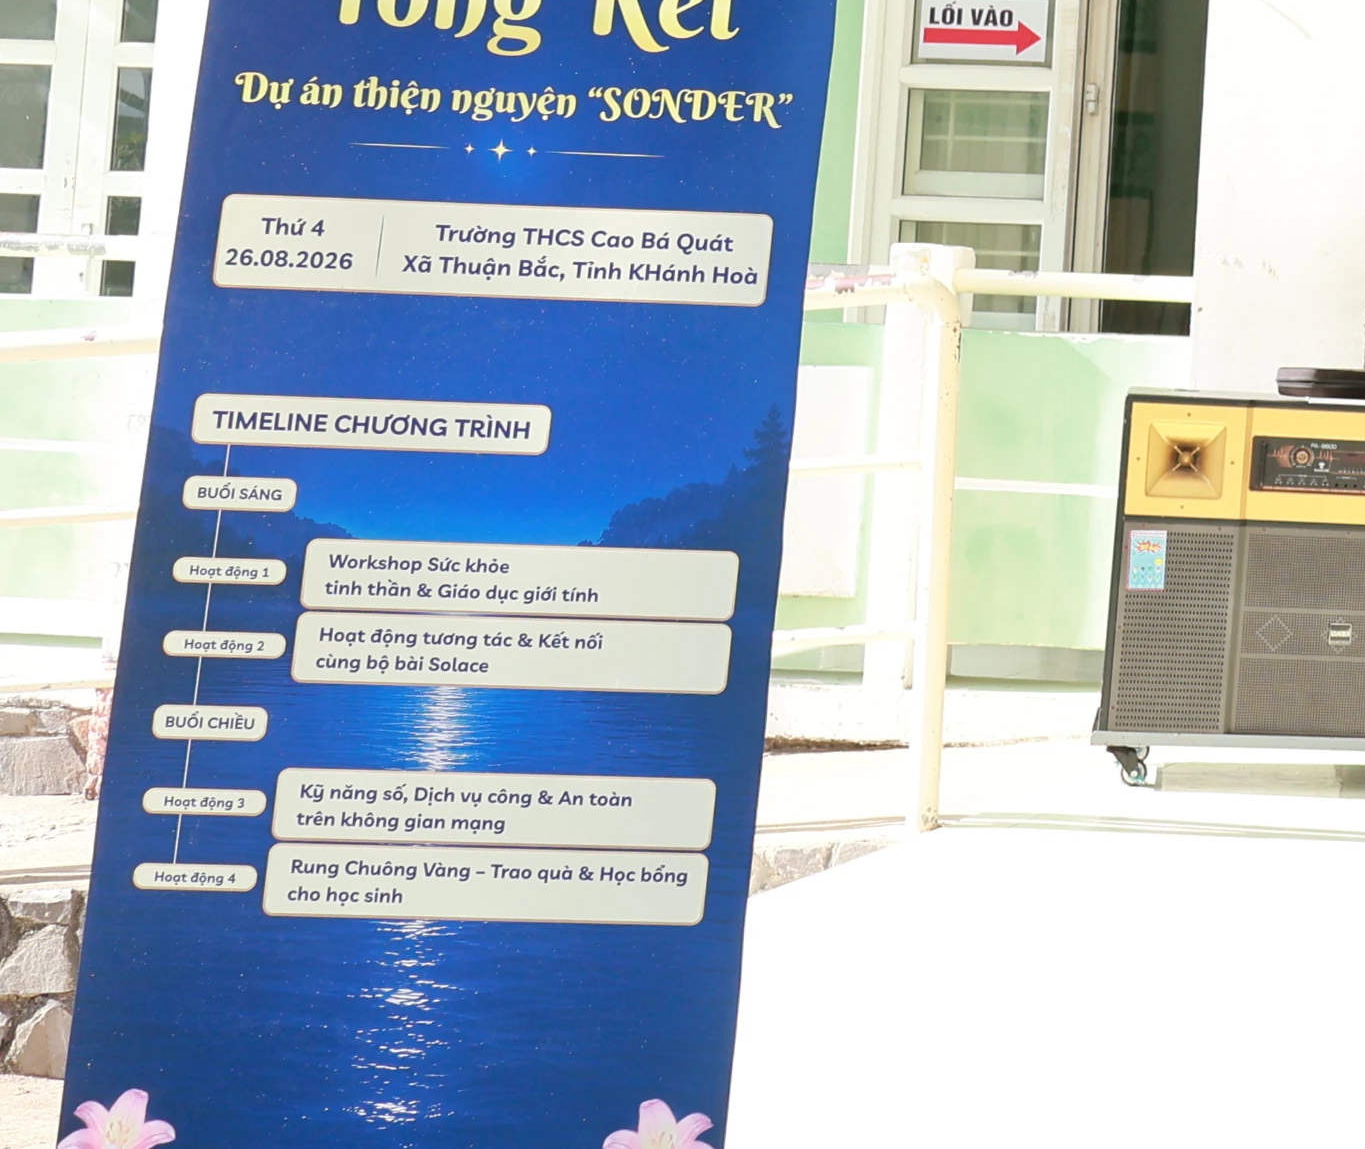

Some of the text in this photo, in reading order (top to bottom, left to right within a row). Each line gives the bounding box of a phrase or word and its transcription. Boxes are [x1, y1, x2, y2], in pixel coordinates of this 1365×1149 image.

[928, 1, 1014, 27] LỐI VÀO
[234, 71, 295, 110] Dự
[299, 76, 343, 108] án
[353, 76, 441, 115] thiện
[451, 86, 577, 123] nguyện
[261, 217, 325, 237] Thứ 4
[435, 224, 734, 255] Trường THCS Cao Bá Quát
[225, 248, 354, 270] 26.08.2026
[402, 254, 759, 285] Xã Thuận Bắc, Tỉnh KHánh Hoà
[212, 410, 531, 439] TIMELINE CHƯƠNG TRÌNH
[197, 481, 283, 502] BUỔI SÁNG
[189, 564, 269, 580] Hoạt động 1
[329, 554, 510, 575] Workshop Sức khỏe
[325, 578, 599, 605] tinh thần & Giáo dục giới tính
[184, 638, 265, 654] Hoạt động 2
[319, 627, 604, 650] Hoạt động tương tác & Kết nối
[315, 653, 489, 675] cùng bộ bài Solace
[165, 710, 255, 730] BUỔI CHIỀU
[164, 796, 245, 811] Hoạt động 3
[299, 783, 633, 809] Kỹ năng số, Dịch vụ công & An toàn
[296, 810, 506, 835] trên không gian mạng
[154, 871, 236, 886] Hoạt động 4
[291, 859, 340, 879] Rung
[345, 860, 418, 881] Chuông
[423, 861, 471, 882] Vàng
[491, 864, 532, 880] Trao
[537, 865, 574, 884] quà
[578, 866, 594, 881] &
[600, 866, 636, 886] Học
[640, 864, 688, 887] bổng
[287, 886, 403, 907] cho học sinh
